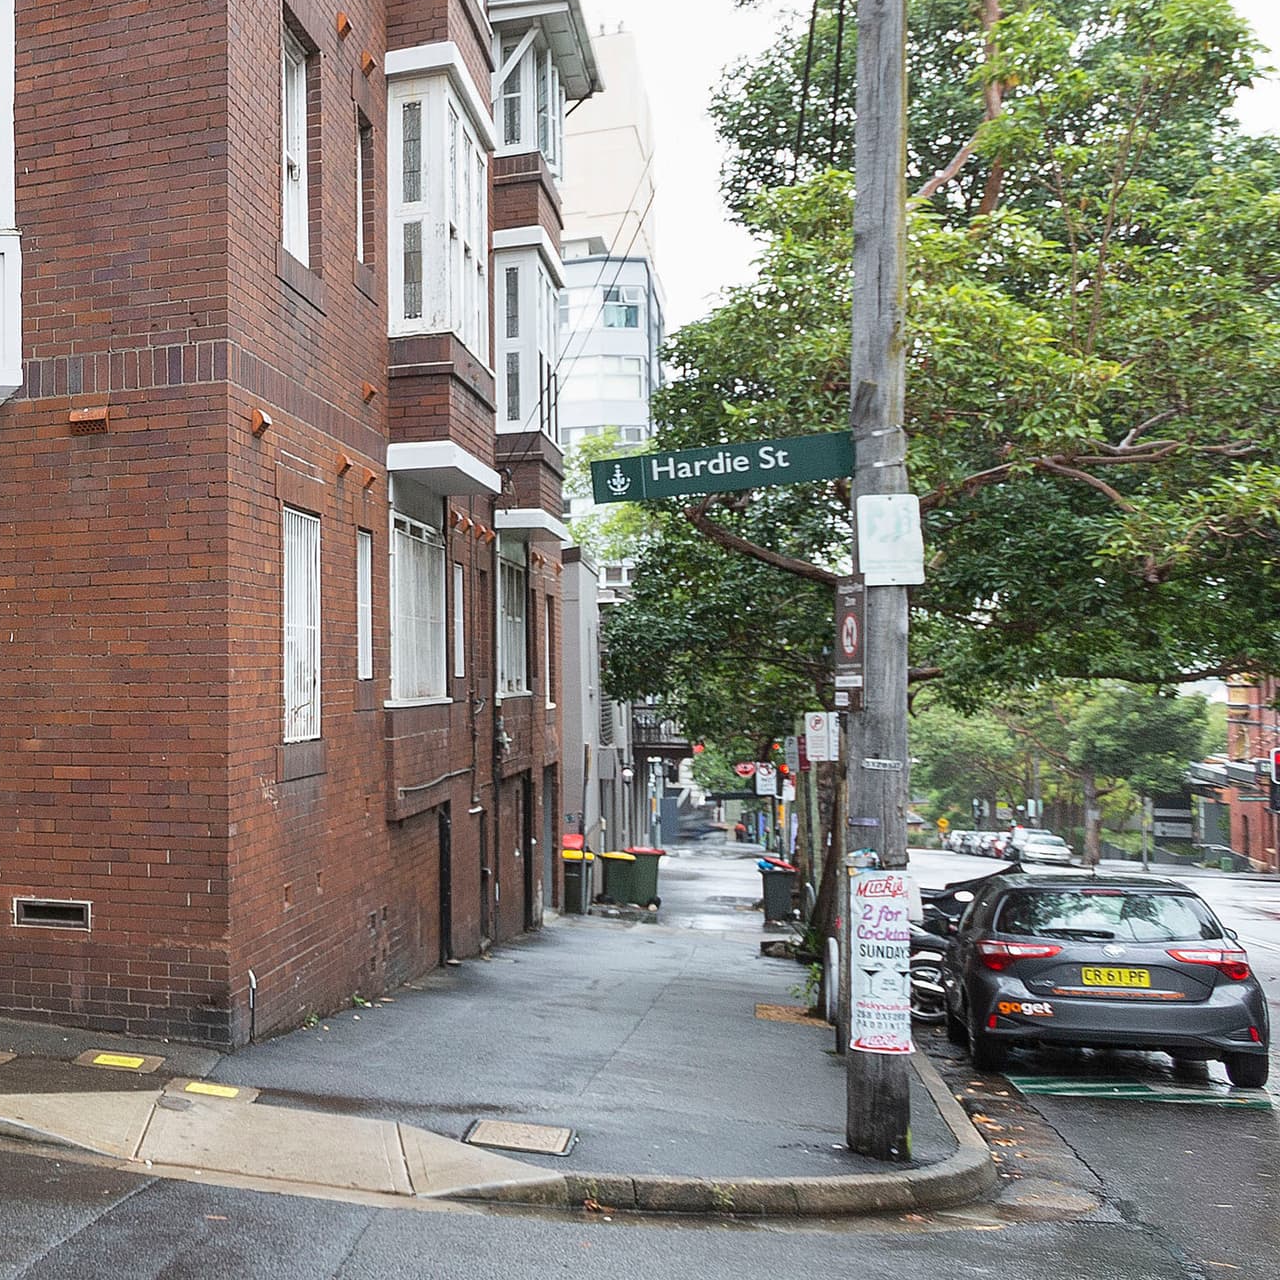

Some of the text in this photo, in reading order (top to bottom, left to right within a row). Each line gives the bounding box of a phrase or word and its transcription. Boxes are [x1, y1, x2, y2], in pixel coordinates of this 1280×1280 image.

[651, 446, 790, 481] Hardie St
[862, 904, 874, 920] 2
[872, 905, 902, 928] for
[997, 1001, 1054, 1016] goget
